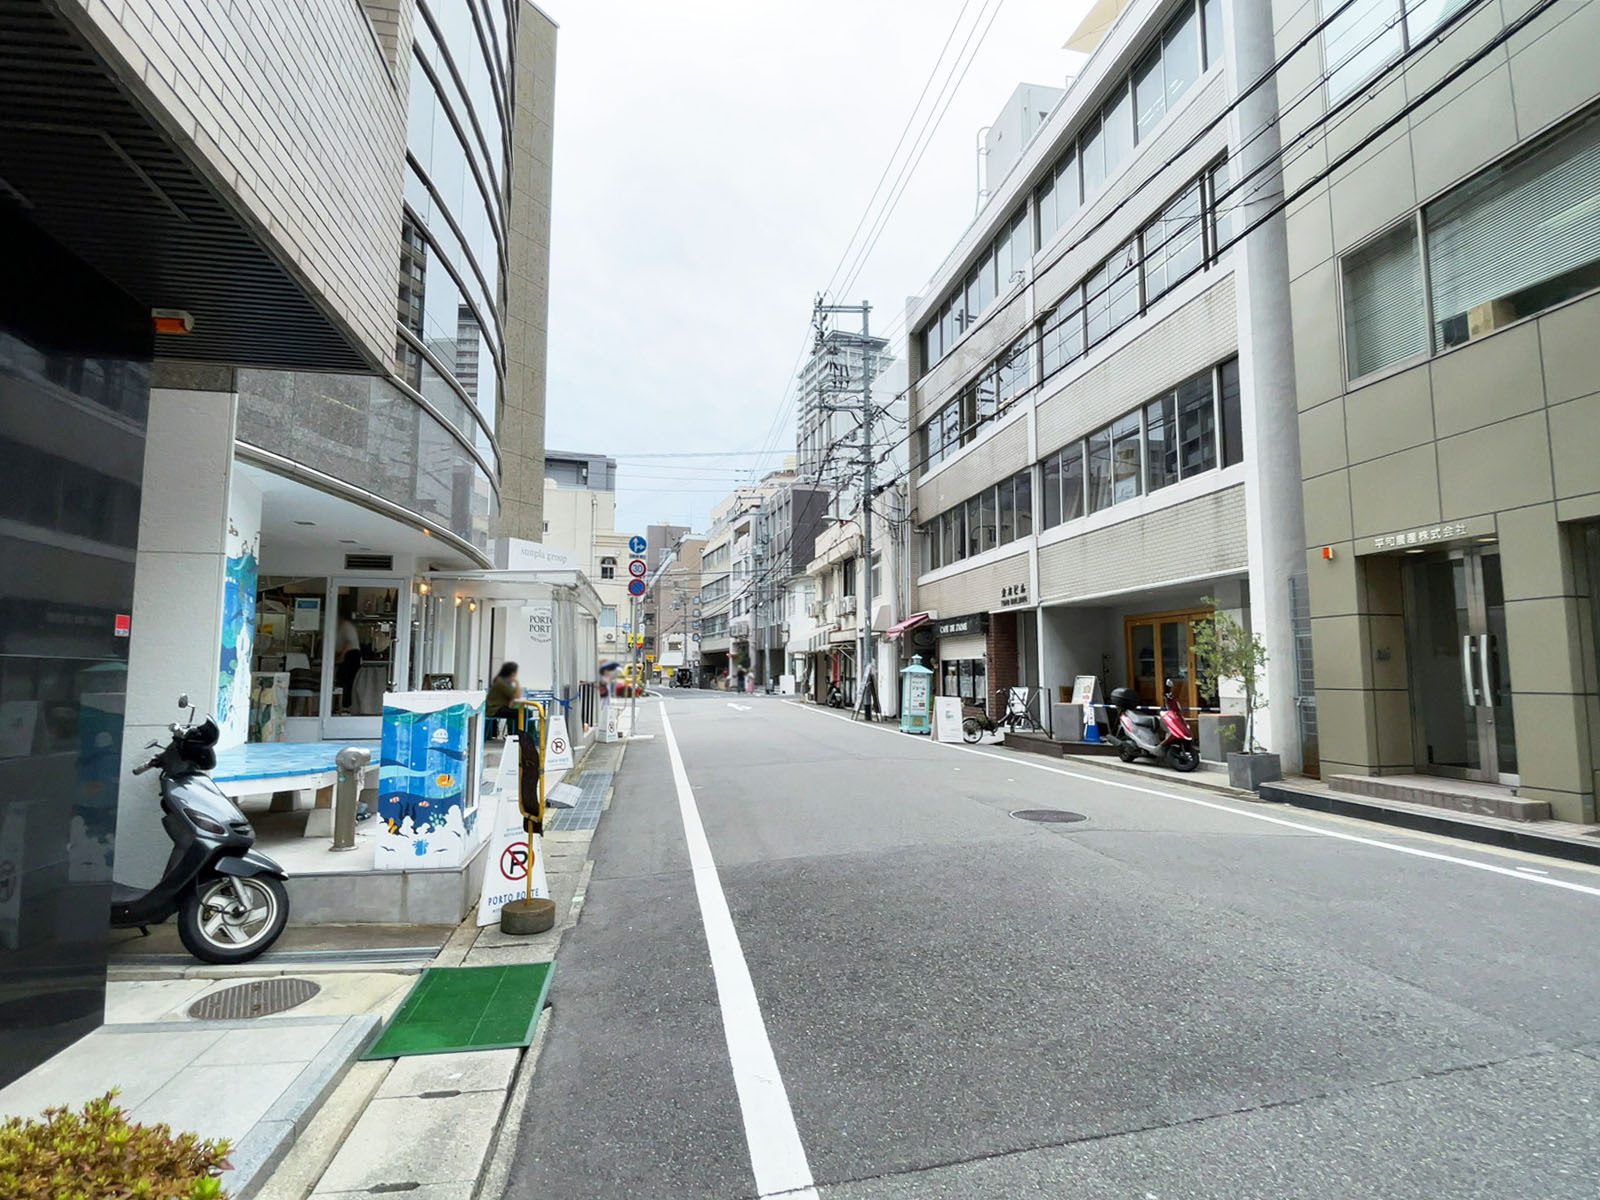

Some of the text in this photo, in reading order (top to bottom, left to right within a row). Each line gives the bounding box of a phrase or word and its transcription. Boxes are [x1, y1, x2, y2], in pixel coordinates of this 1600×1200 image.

[632, 564, 643, 573] 30
[529, 625, 551, 633] PORT
[488, 888, 540, 906] PORTO POTE
